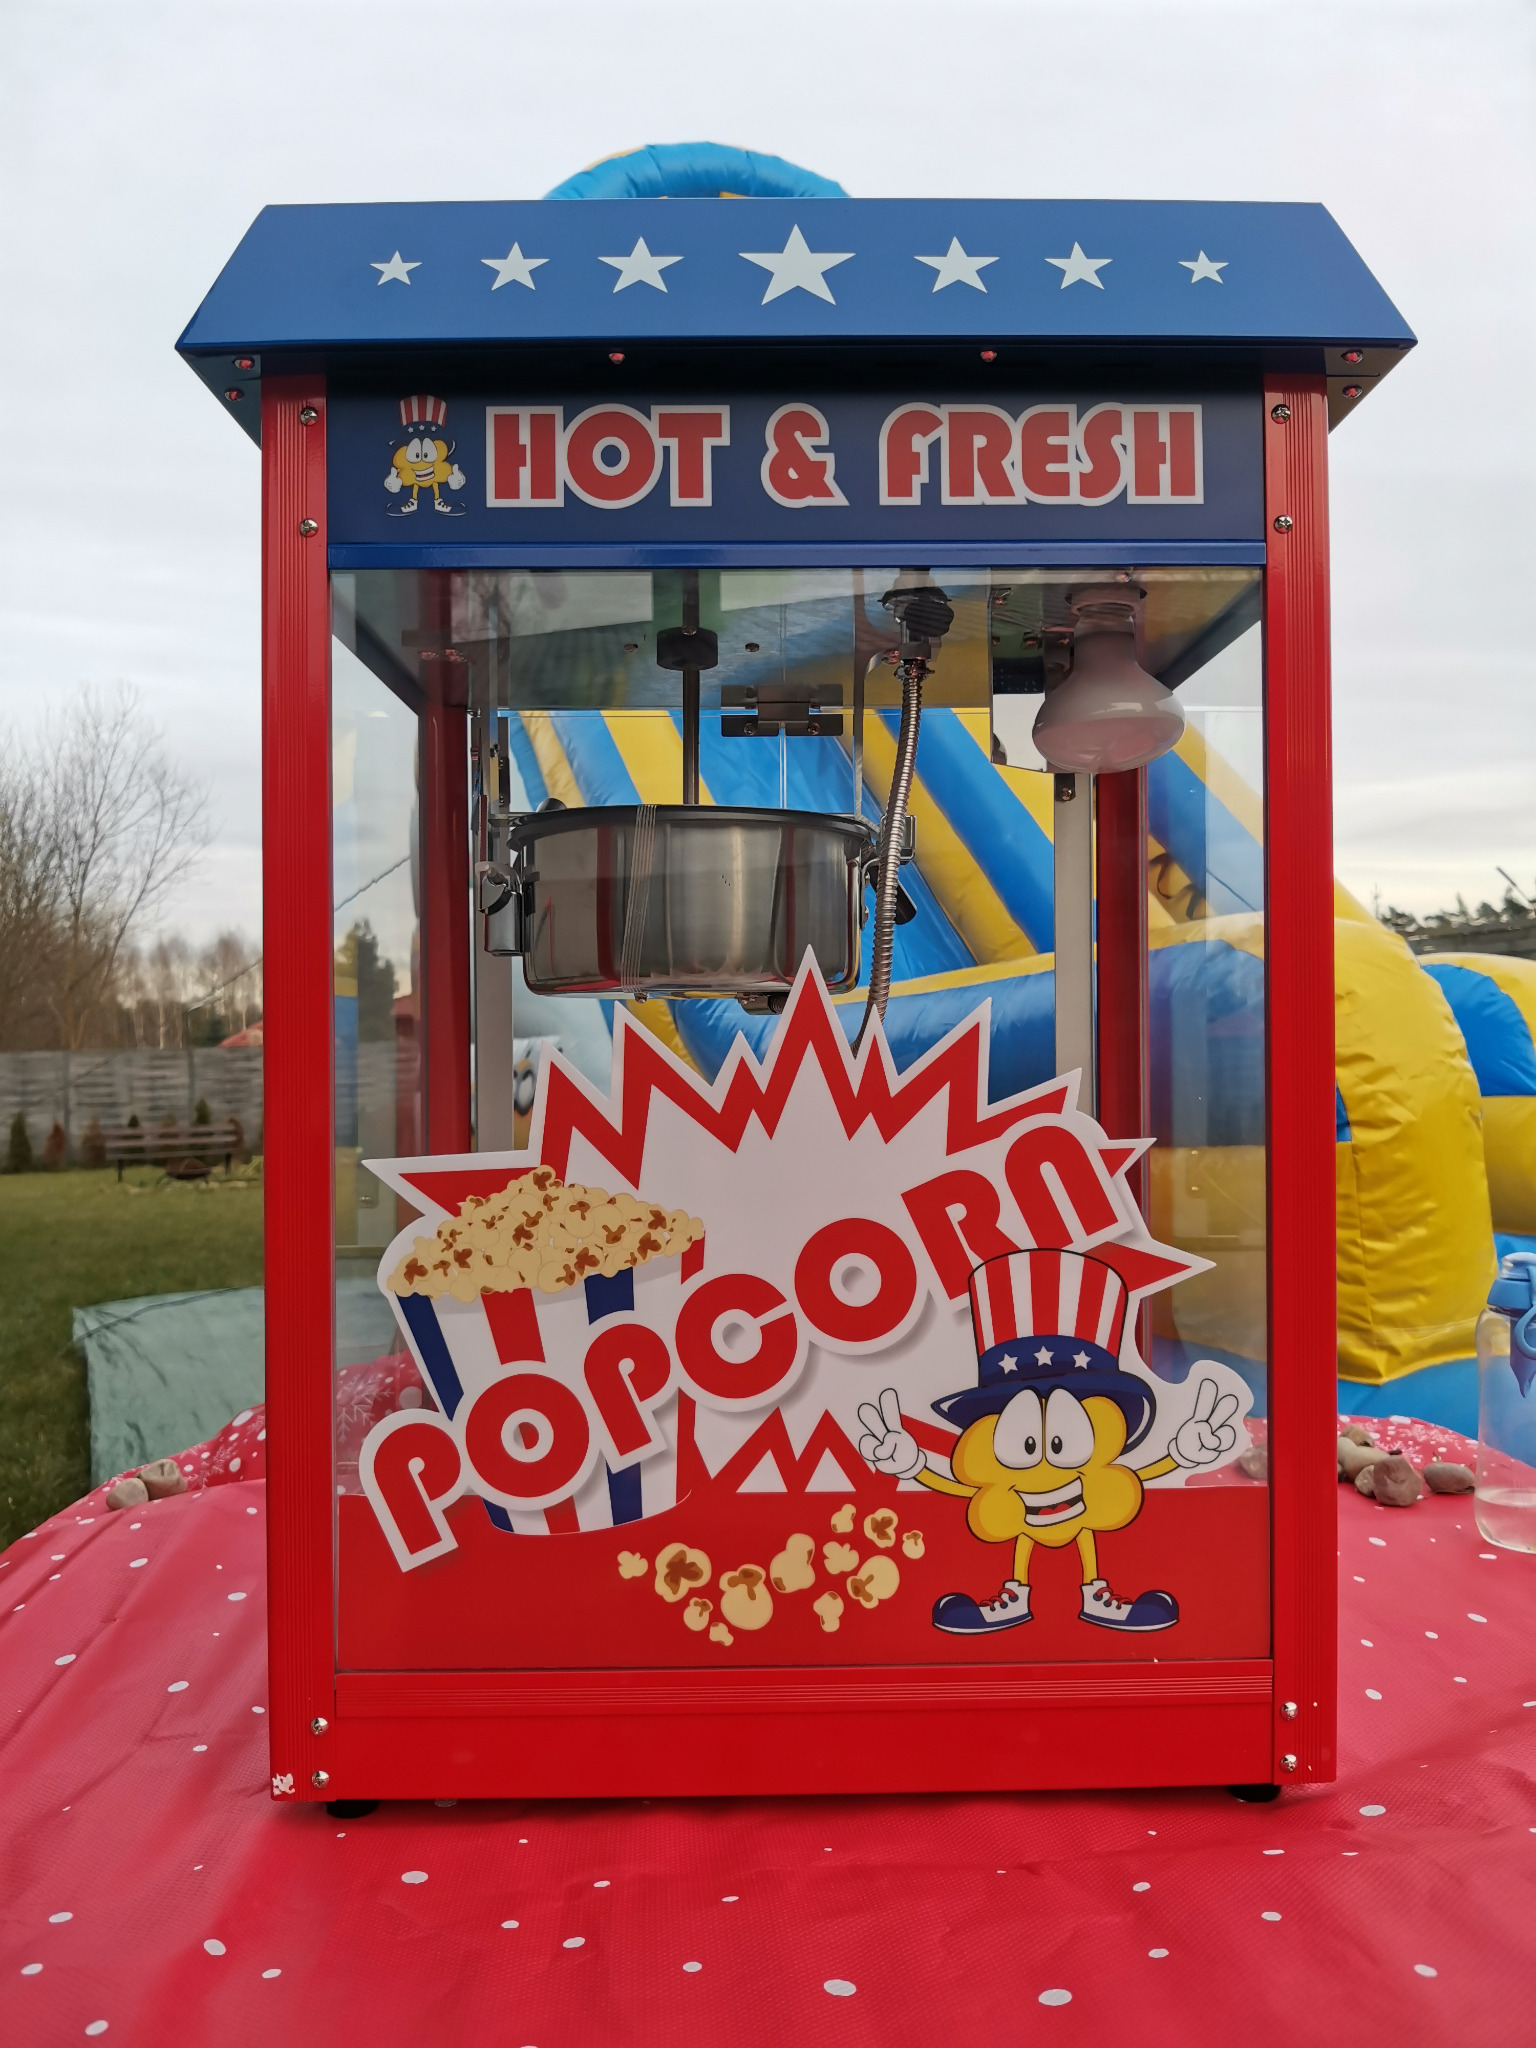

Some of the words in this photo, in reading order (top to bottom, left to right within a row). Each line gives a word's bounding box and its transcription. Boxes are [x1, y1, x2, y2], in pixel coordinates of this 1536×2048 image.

[486, 404, 730, 509] HOT
[761, 404, 849, 507] &
[879, 402, 1204, 507] FRESH
[363, 1114, 1130, 1570] POPCORN
